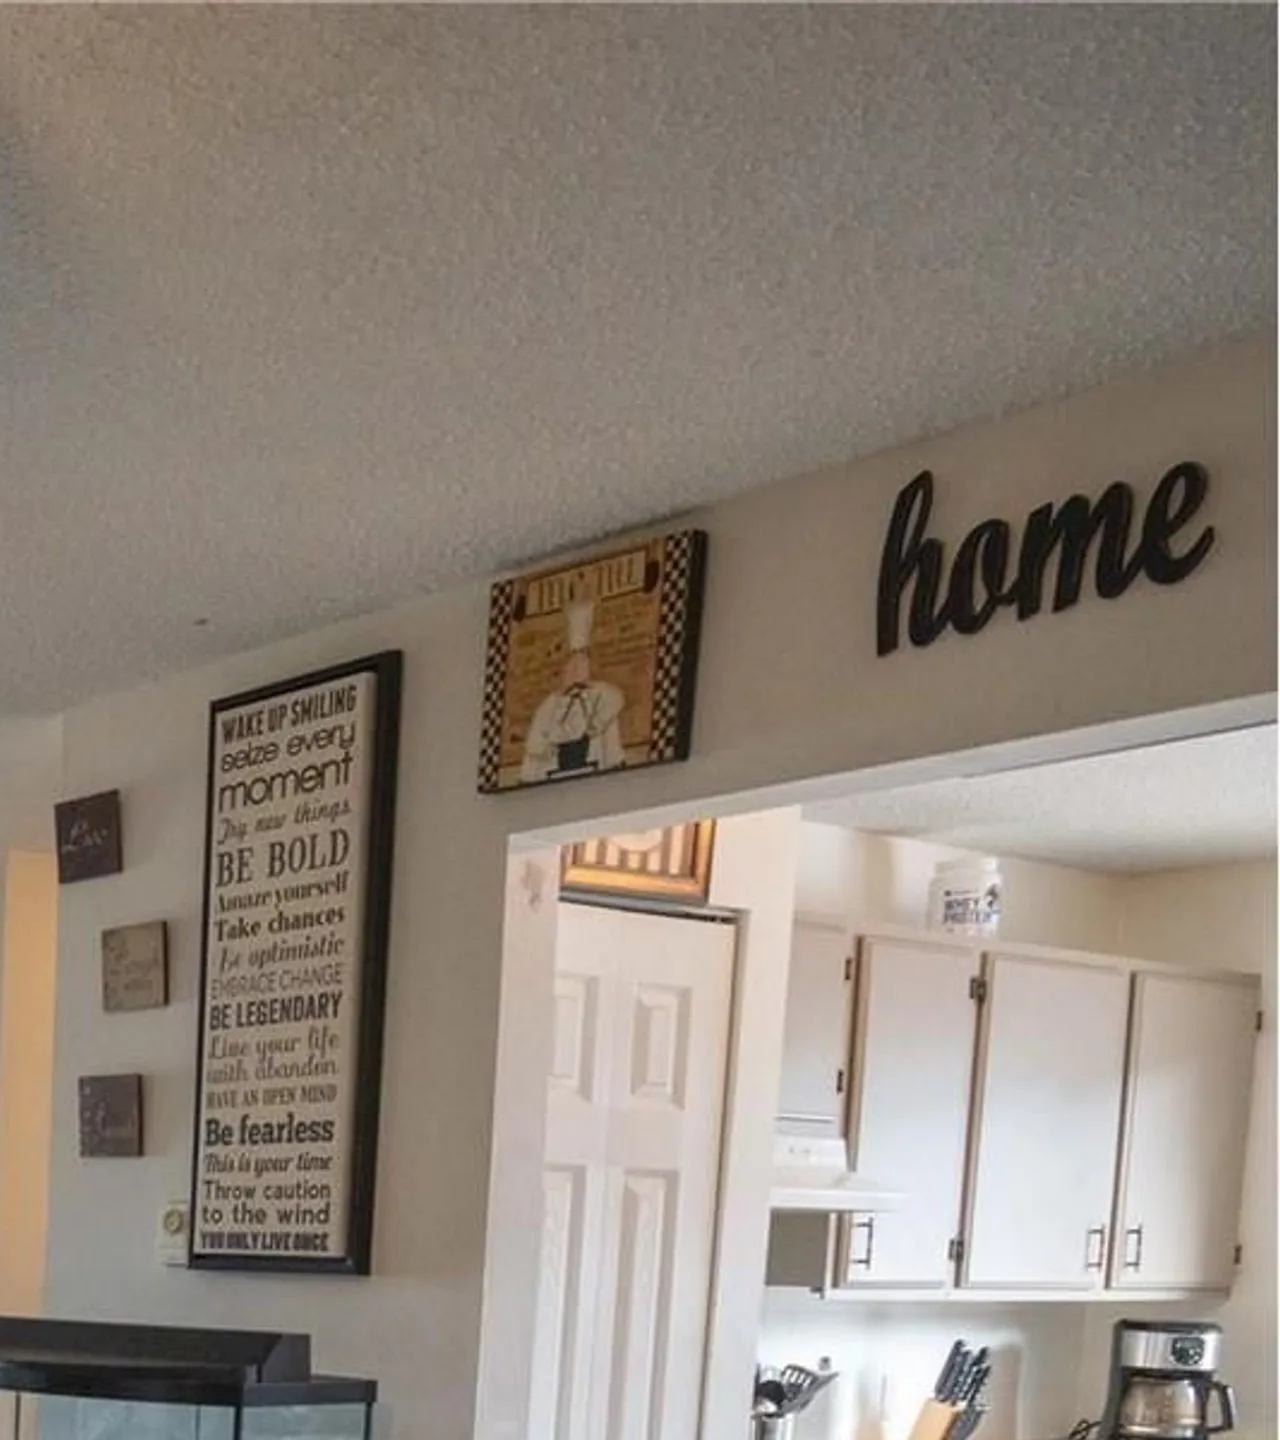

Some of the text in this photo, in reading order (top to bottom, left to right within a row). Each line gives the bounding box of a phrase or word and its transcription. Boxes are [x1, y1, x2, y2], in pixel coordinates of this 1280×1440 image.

[877, 461, 1215, 657] home
[221, 685, 358, 744] WAKE UP SMILING
[221, 721, 356, 773] seize every
[218, 751, 354, 813] moment
[217, 798, 352, 845] Try new things
[216, 828, 350, 887] BE BOLD
[216, 871, 349, 914] Amaze yourself
[215, 905, 345, 942] Take chances
[247, 931, 344, 970] optimistic
[211, 963, 344, 999] EMBRACE CHANGE
[210, 993, 343, 1031] BE LEGENDARY
[208, 1026, 339, 1063] Live your life
[206, 1055, 338, 1084] with abandon
[206, 1083, 338, 1110] HAVE AN OPEN MIND
[204, 1111, 335, 1147] Be fearless
[204, 1152, 332, 1179] This is your time
[203, 1179, 331, 1200] Throw caution
[201, 1201, 331, 1225] to the wind
[262, 1232, 291, 1250] LIVE
